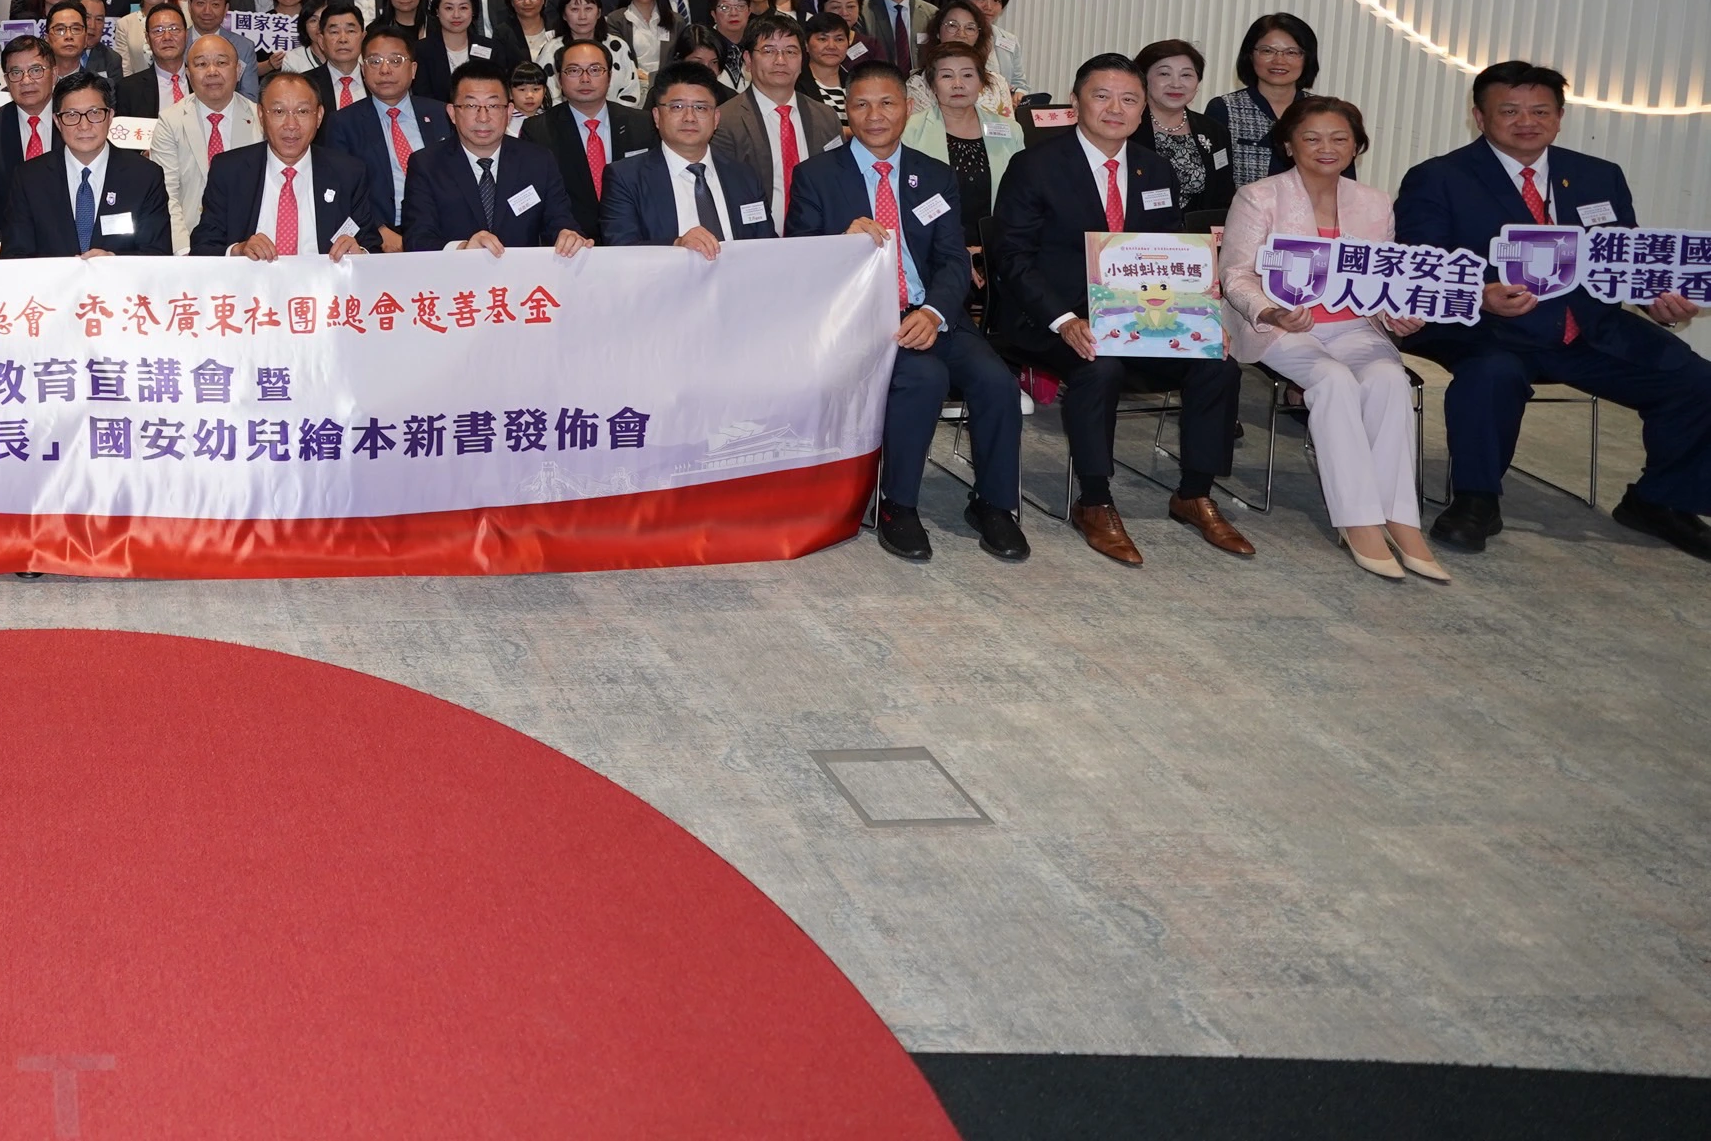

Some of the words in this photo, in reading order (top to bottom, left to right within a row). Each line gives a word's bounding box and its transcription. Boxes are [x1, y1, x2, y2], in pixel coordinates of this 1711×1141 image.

[1107, 262, 1202, 278] 小蝌蚪找媽媽
[1336, 242, 1482, 286] 國家安全
[75, 285, 561, 339] 香港廣東社團總會慈善基金
[1332, 278, 1477, 321] 人人有責
[258, 366, 293, 401] 暨
